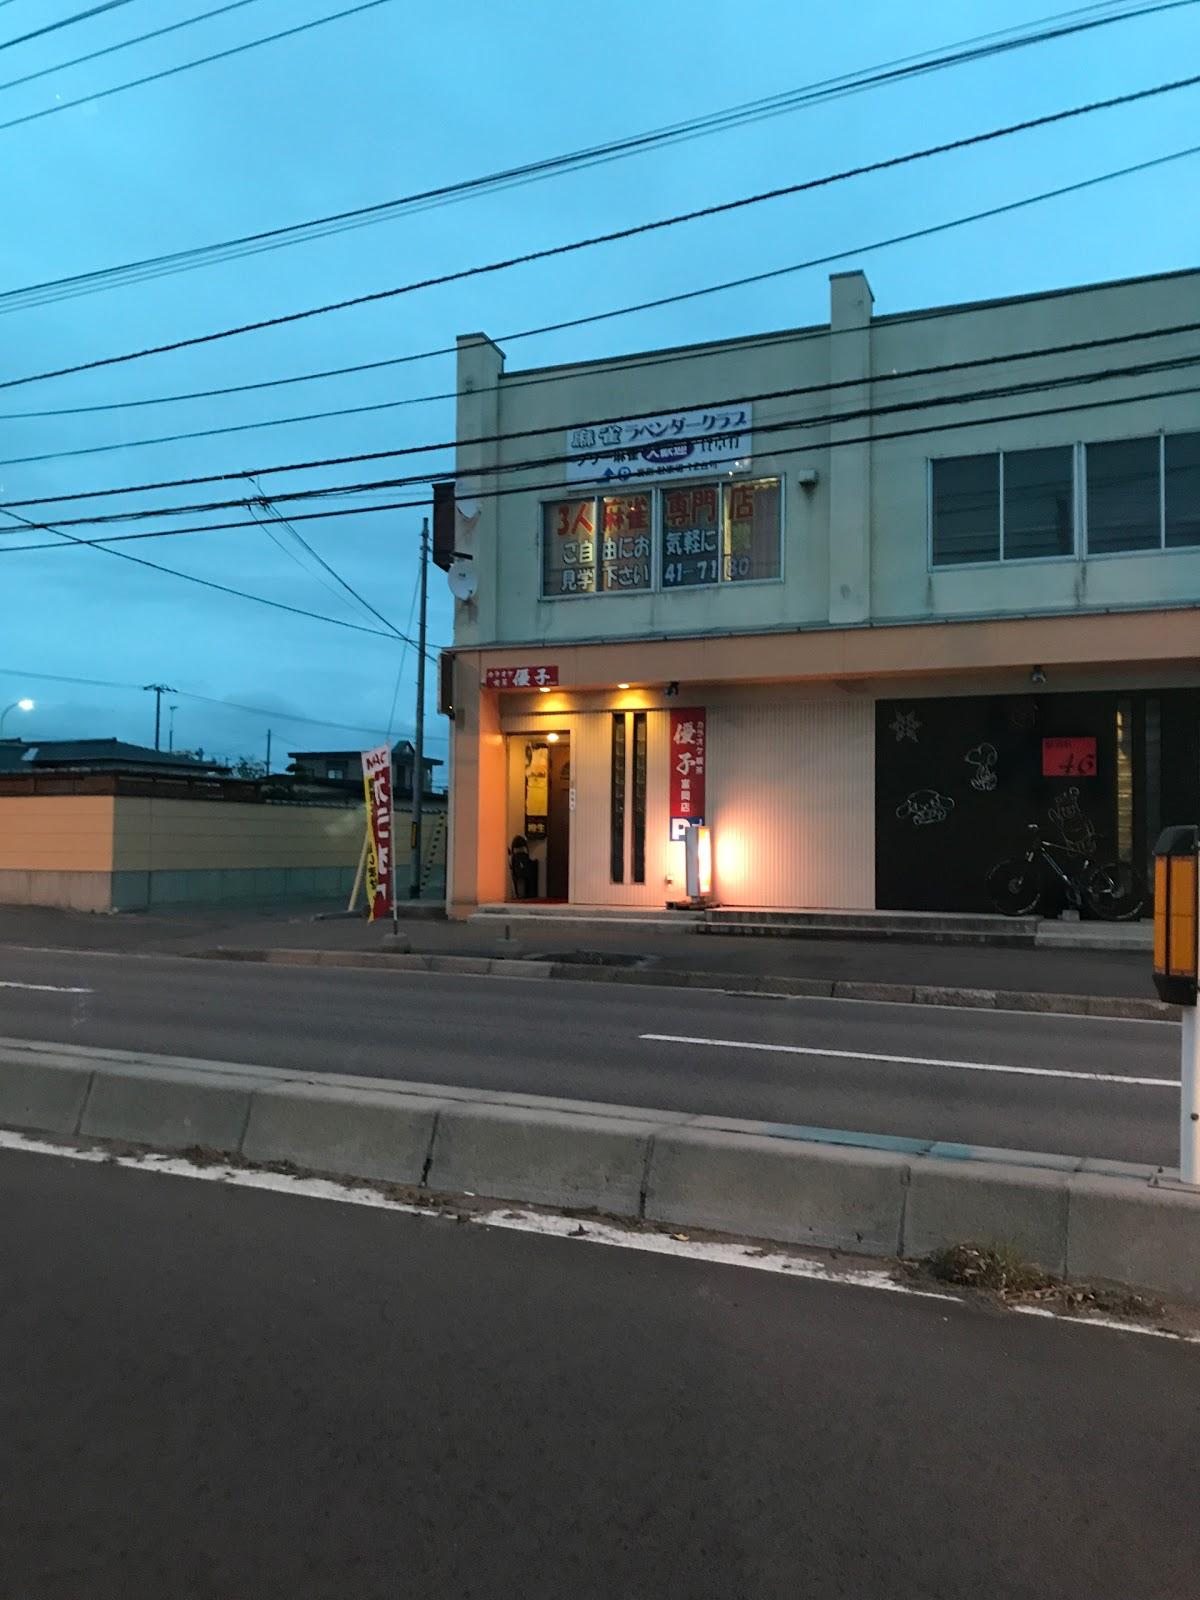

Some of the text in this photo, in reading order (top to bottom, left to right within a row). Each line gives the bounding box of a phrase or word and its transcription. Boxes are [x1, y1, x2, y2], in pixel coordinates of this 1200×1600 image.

[561, 565, 649, 591] 見学下さい
[672, 817, 691, 839] P
